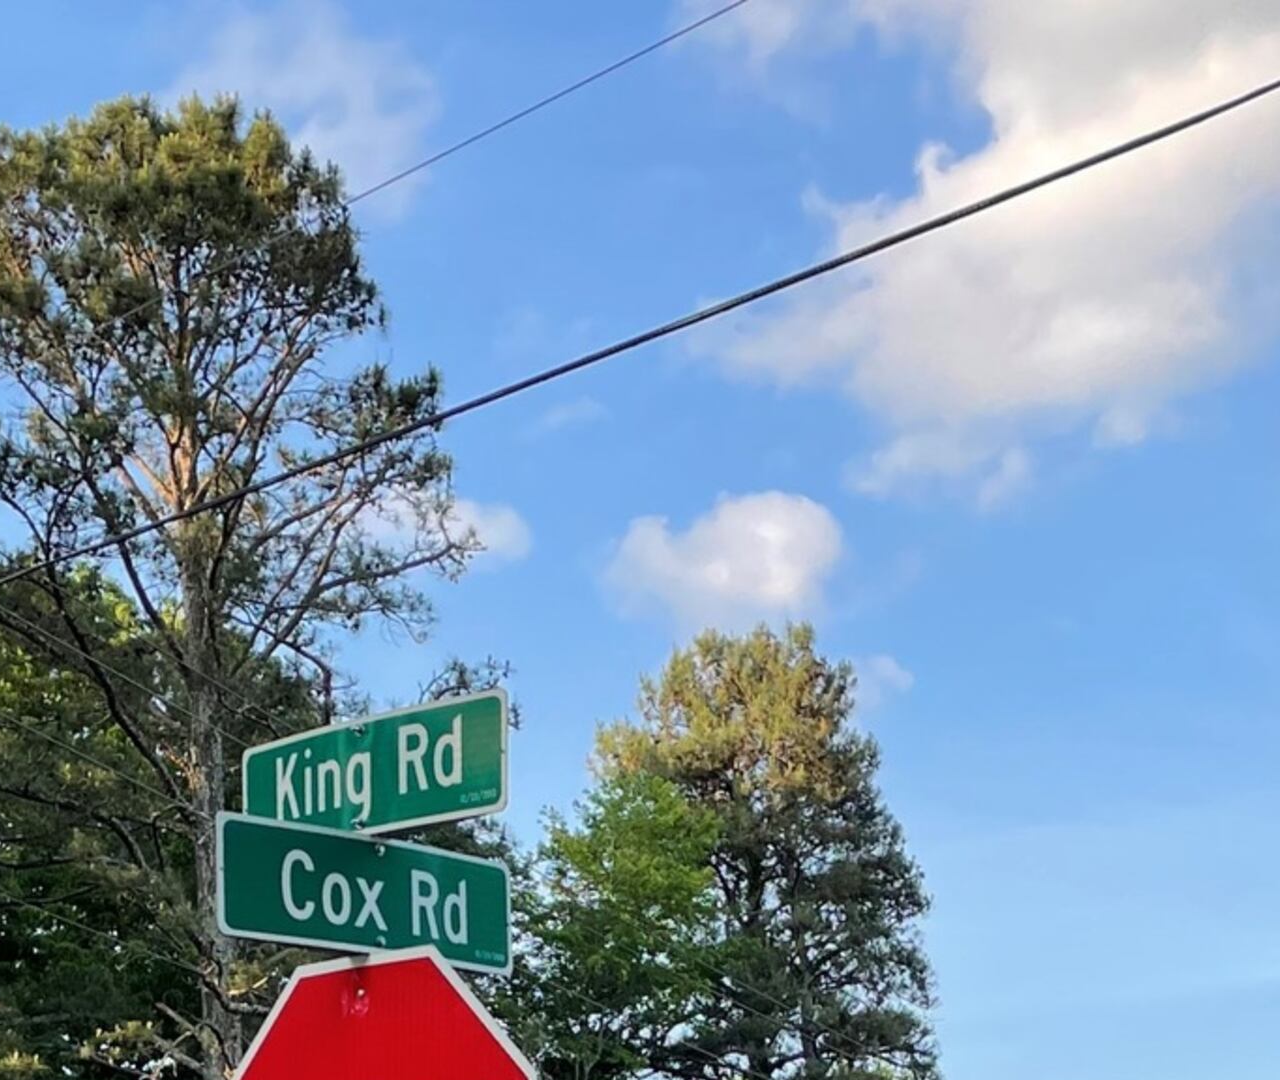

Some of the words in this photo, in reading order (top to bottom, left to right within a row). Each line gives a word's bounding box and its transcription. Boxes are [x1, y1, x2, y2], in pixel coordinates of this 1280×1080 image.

[275, 748, 371, 830] King
[397, 714, 463, 796] Rd
[281, 849, 389, 932] Cox
[411, 869, 468, 945] Rd
